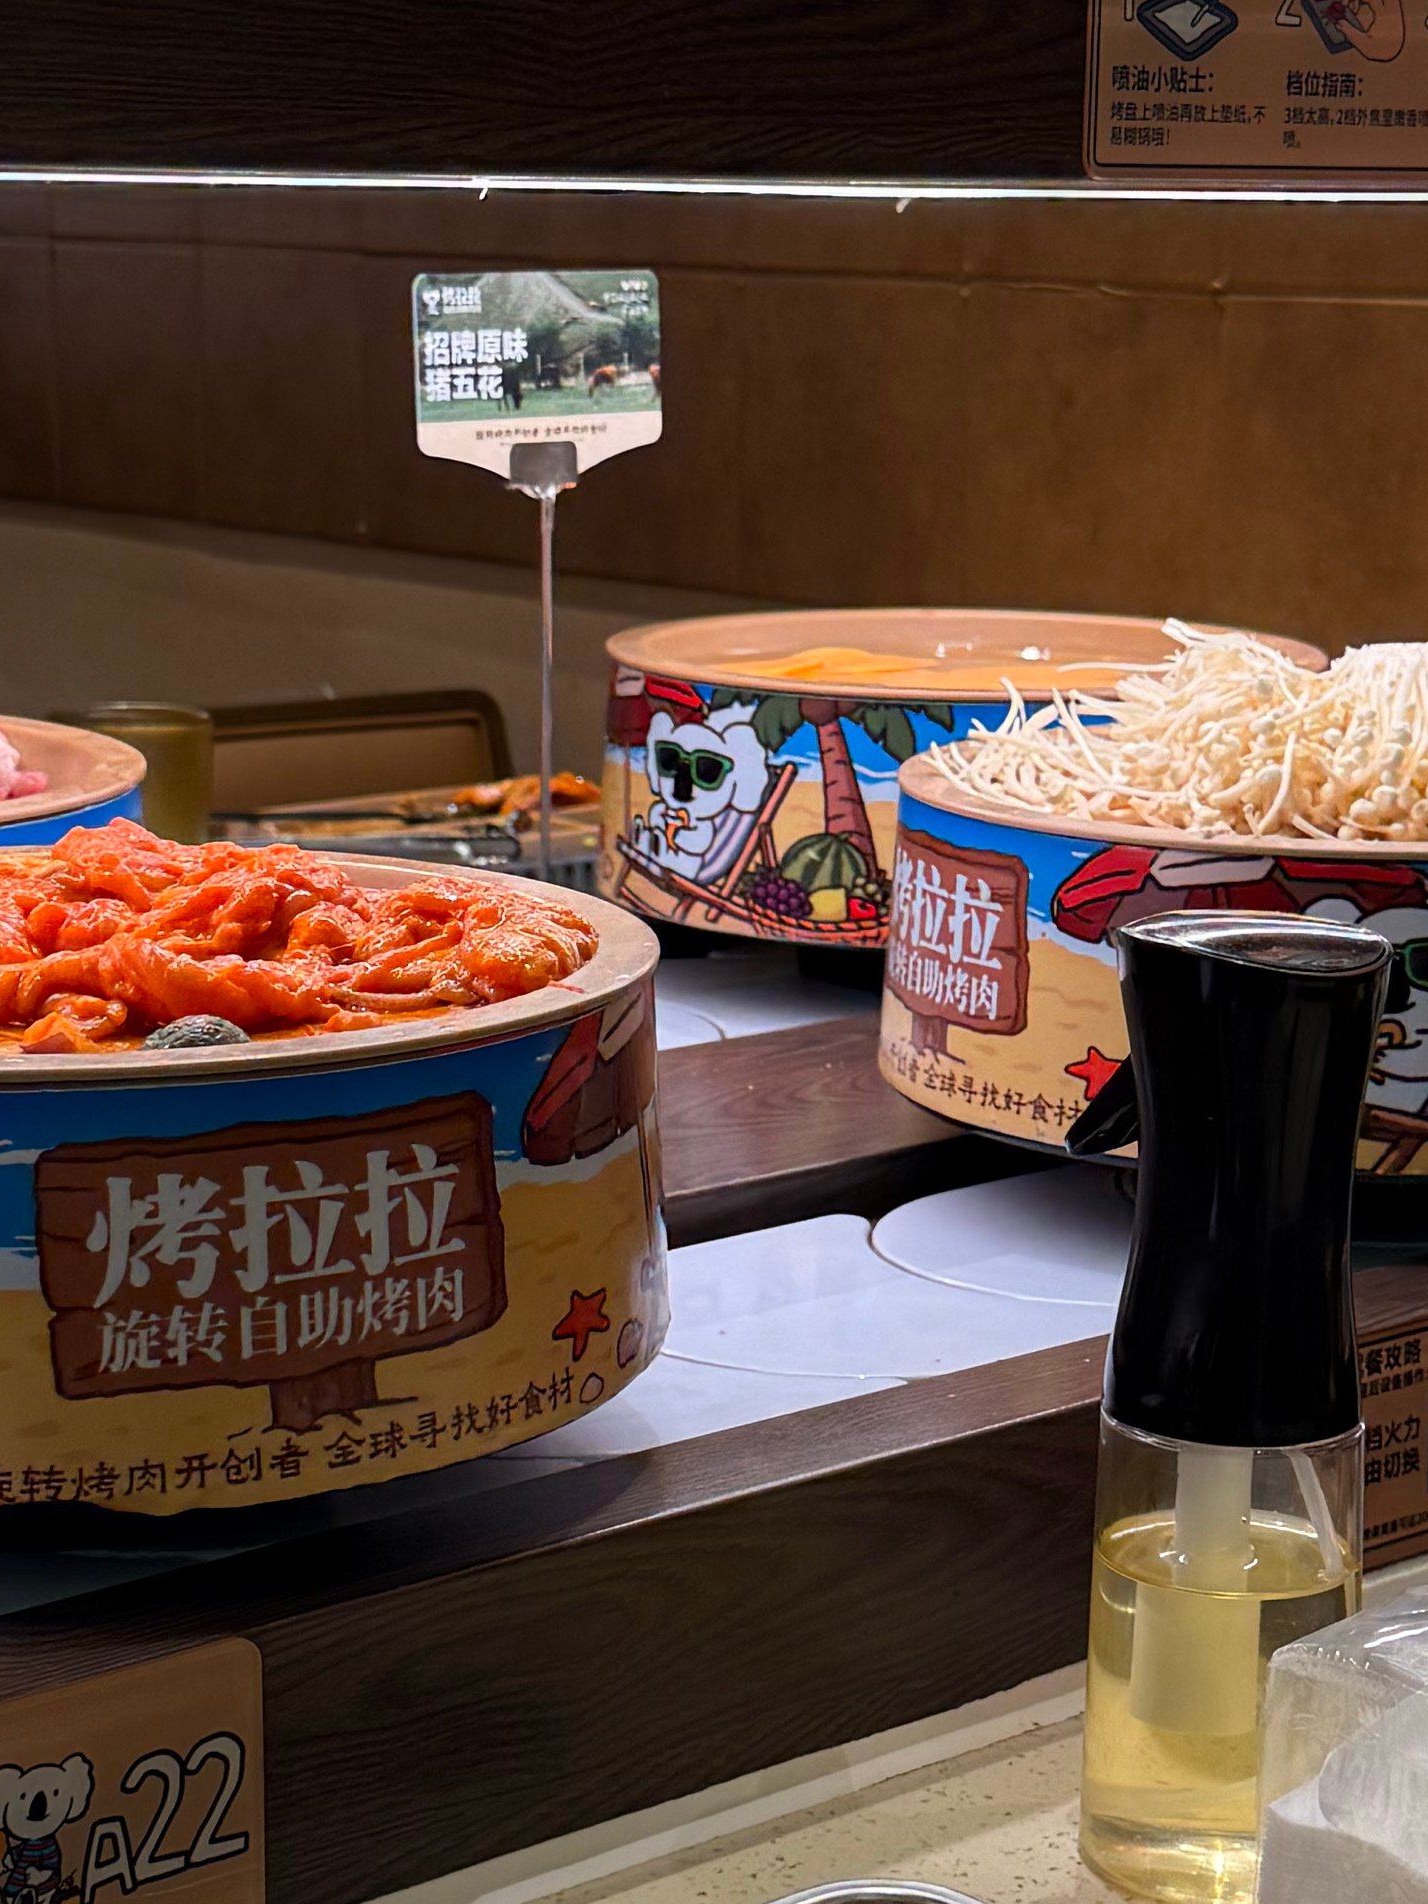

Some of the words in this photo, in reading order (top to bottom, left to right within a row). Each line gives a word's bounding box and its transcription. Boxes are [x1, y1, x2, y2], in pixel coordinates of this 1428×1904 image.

[1112, 64, 1214, 95] 喷油小贴士:
[1286, 70, 1364, 99] 档位指南:
[423, 328, 528, 366] 招牌原味
[84, 1142, 469, 1311] 烤拉拉
[97, 1262, 468, 1379] 旋转自助烤肉
[1358, 1338, 1421, 1379] 餐攻略
[322, 1366, 579, 1472] 全球寻找好食材
[82, 1730, 250, 1903] A22
